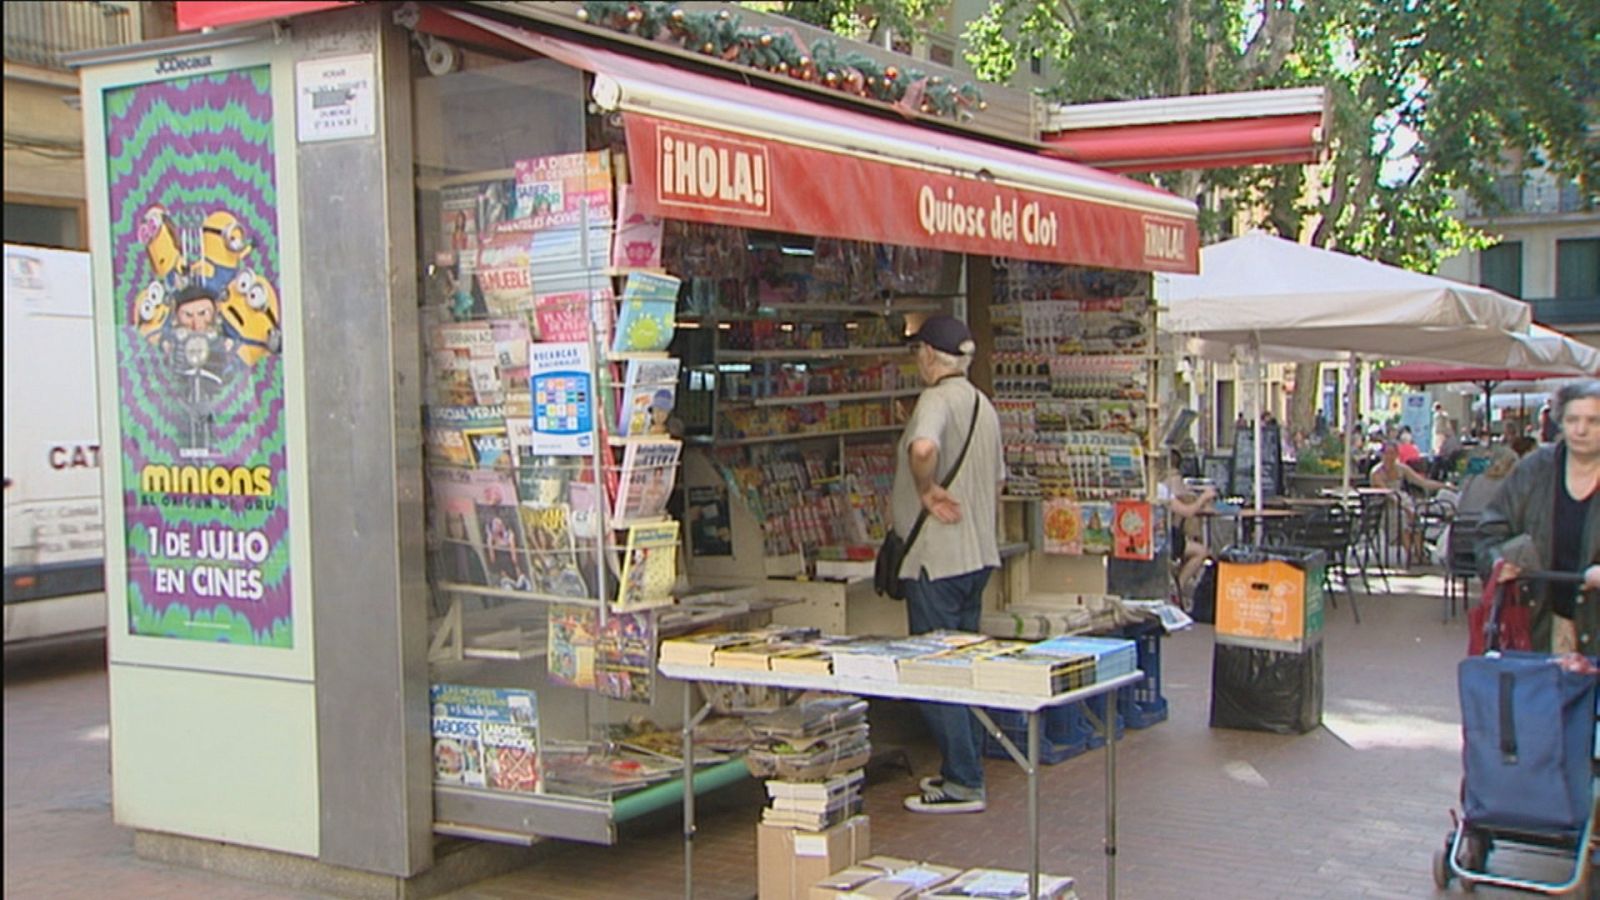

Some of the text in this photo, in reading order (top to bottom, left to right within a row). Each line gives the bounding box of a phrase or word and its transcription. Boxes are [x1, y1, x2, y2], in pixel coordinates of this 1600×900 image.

[155, 55, 212, 73] JCDecaux
[663, 135, 764, 207] ¡HOLA!
[919, 185, 1057, 246] Quiosc del Clot
[149, 526, 269, 563] 1 DE JULIO
[156, 565, 263, 601] EN CINES
